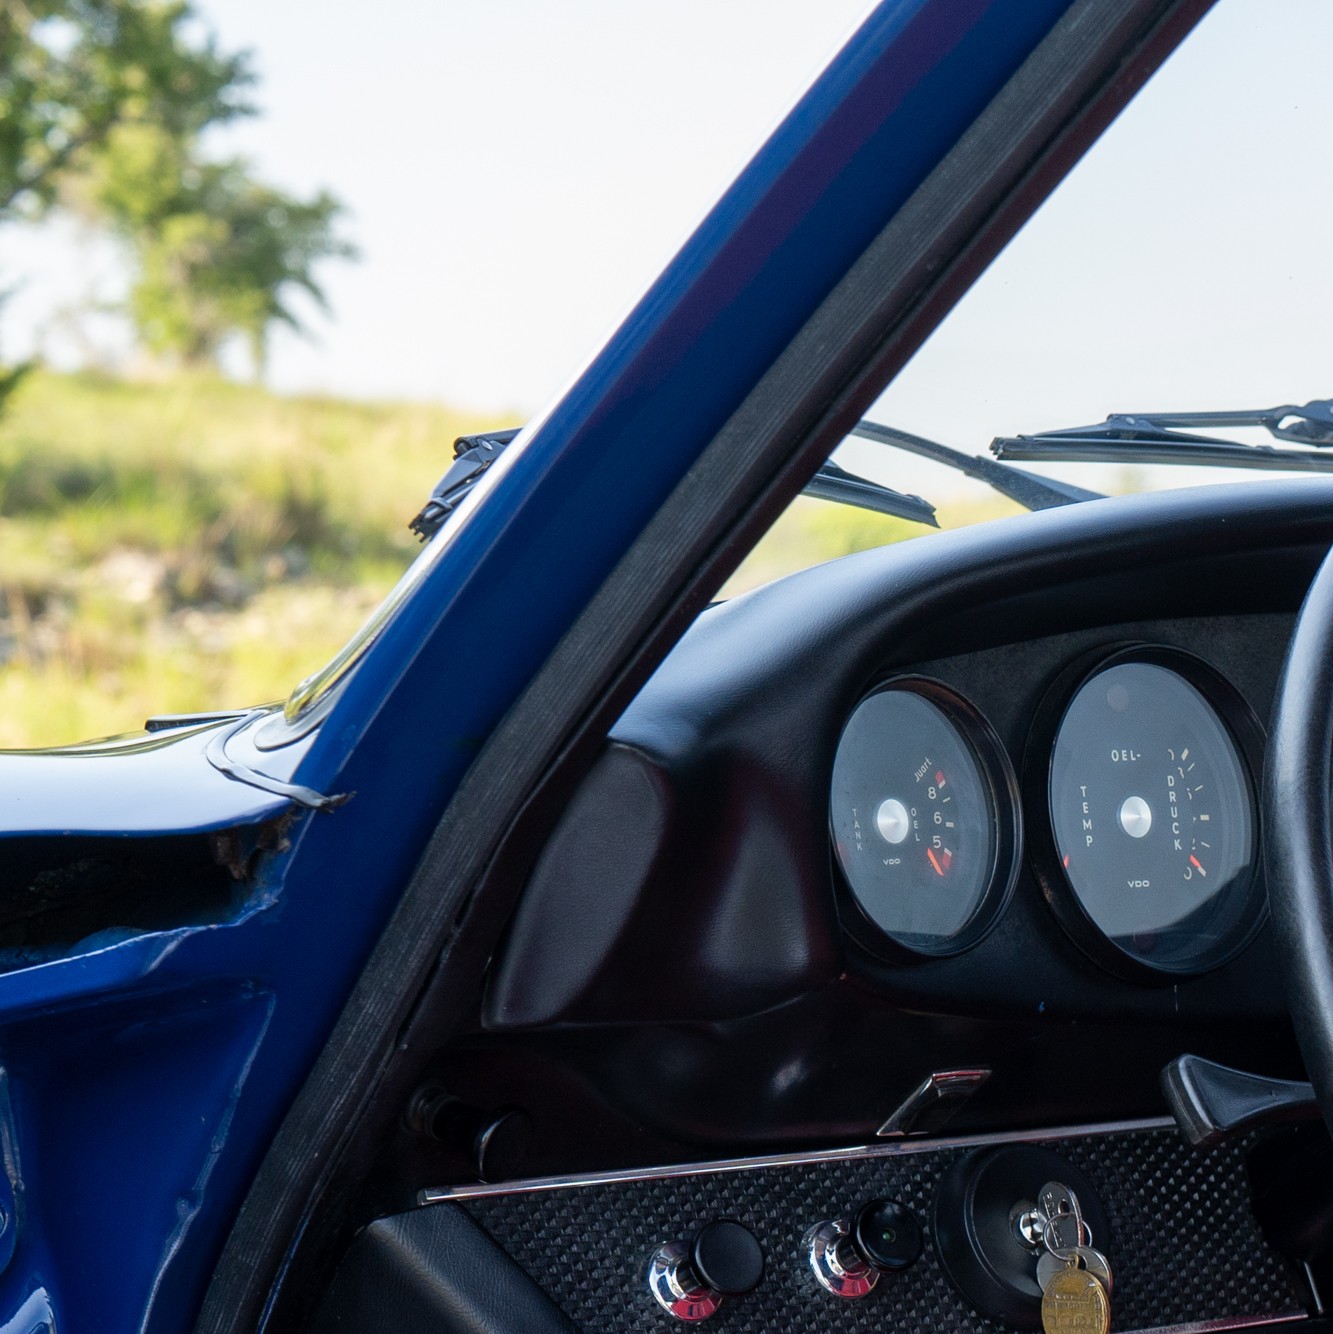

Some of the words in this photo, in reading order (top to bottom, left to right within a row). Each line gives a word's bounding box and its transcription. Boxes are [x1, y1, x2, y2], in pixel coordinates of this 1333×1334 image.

[928, 786, 937, 799] 8
[933, 811, 942, 825] 6
[1080, 786, 1093, 847] TEMP
[1167, 775, 1182, 851] DRUCK
[852, 808, 862, 851] TANK
[932, 835, 941, 849] 5
[883, 858, 900, 866] VDO
[1127, 880, 1150, 888] VDO
